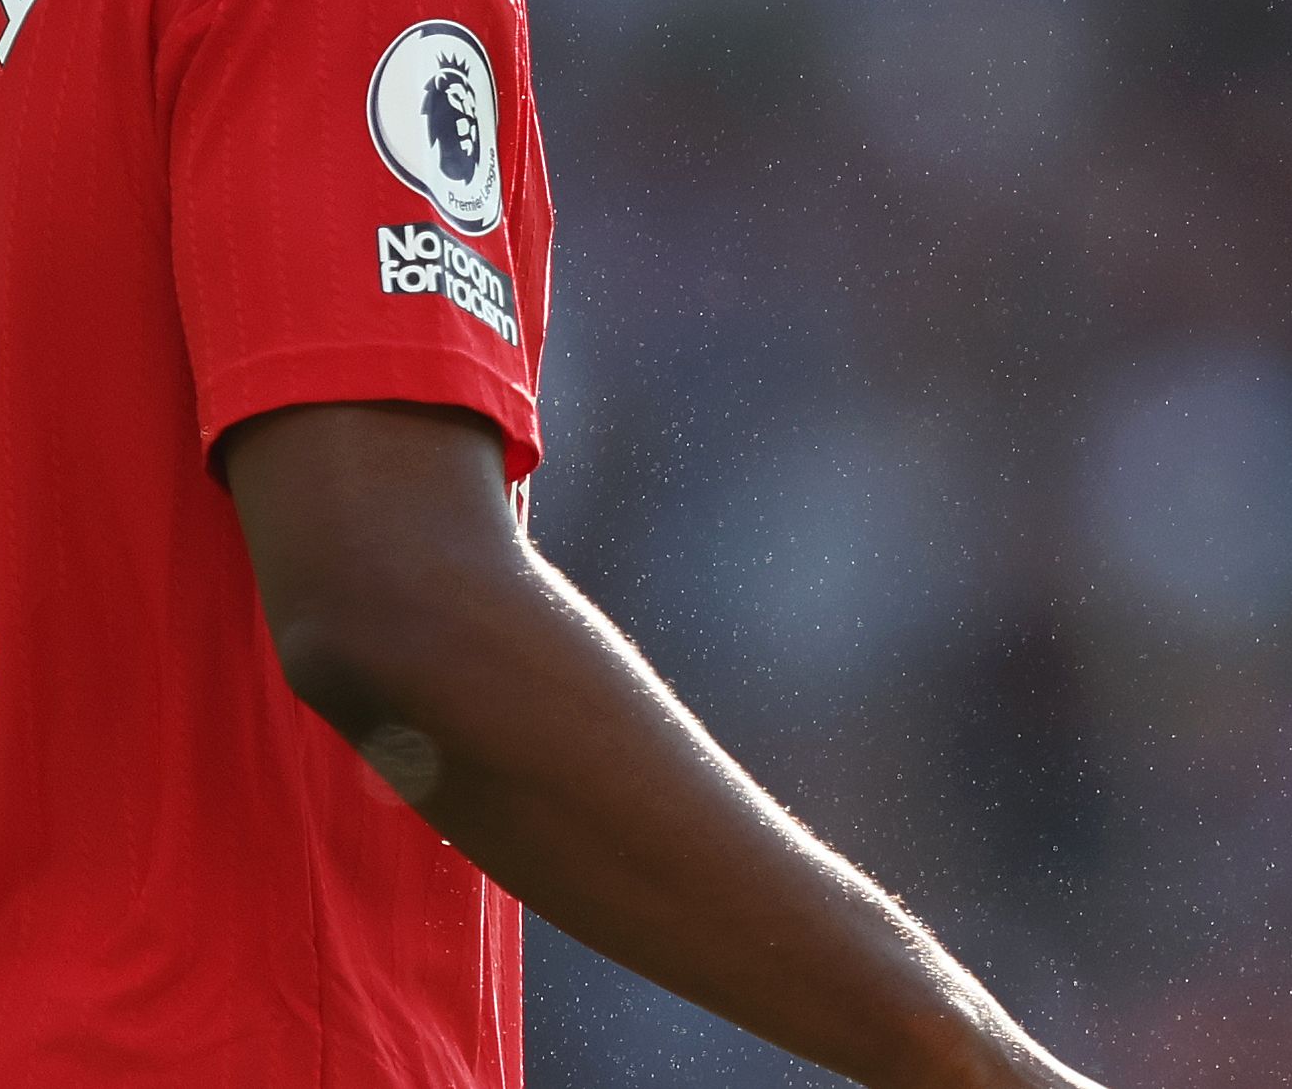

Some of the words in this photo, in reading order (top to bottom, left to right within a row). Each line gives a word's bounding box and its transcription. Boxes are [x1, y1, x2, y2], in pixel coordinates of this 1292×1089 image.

[448, 191, 483, 211] Premier
[480, 147, 496, 200] League
[378, 225, 441, 262] No
[443, 239, 504, 308] room
